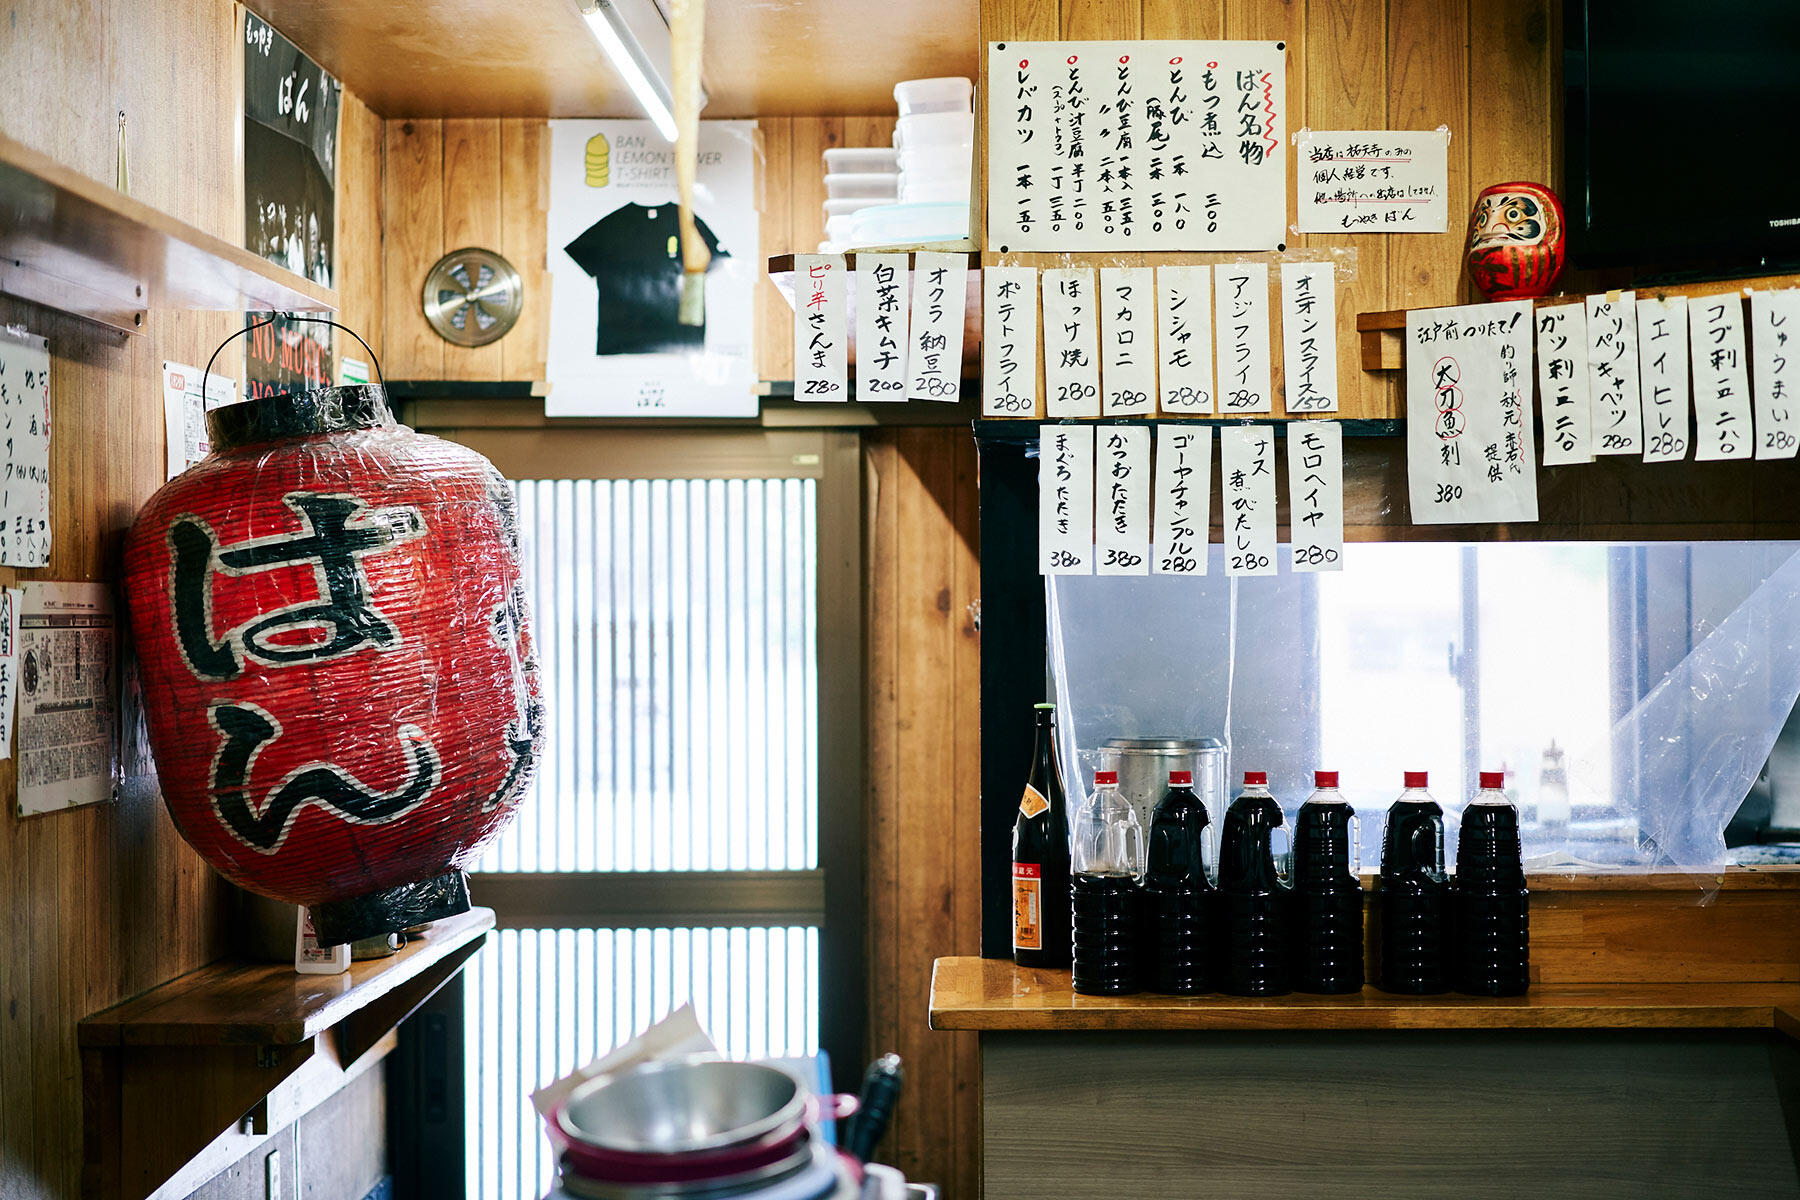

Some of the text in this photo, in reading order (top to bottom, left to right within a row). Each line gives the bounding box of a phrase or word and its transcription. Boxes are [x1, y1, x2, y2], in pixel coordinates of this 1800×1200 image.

[277, 70, 309, 124] ばん
[1018, 71, 1037, 143] レバカツ
[1170, 70, 1193, 125] とんび
[1200, 70, 1223, 159] もつ煮込
[1237, 70, 1267, 165] ばん名物
[616, 136, 645, 148] BAN
[616, 152, 668, 165] LEMON
[1173, 155, 1188, 176] 一本
[1016, 165, 1033, 189] 一本
[873, 264, 899, 370] 白菜キムチ
[1061, 280, 1088, 368] ほっけ焼
[1116, 287, 1133, 365] マカロニ
[252, 314, 275, 364] NO
[996, 279, 1022, 392] ポテトフライ
[1169, 290, 1191, 367] シシャモ
[1229, 277, 1252, 384] アジフライ
[1651, 319, 1671, 429] エイヒレ
[1771, 312, 1788, 422] しゅうまい
[805, 380, 839, 394] 280
[869, 379, 903, 392] 200
[914, 376, 957, 398] 280
[1058, 383, 1095, 401] 280
[1168, 387, 1208, 405] 280
[993, 393, 1033, 412] 280
[1112, 390, 1146, 407] 280
[1227, 390, 1259, 407] 280
[1291, 396, 1333, 411] 150
[1603, 435, 1632, 449] 280
[1650, 432, 1684, 455] 280
[1766, 431, 1795, 449] 280
[1301, 433, 1326, 527] モロヘイヤ
[1434, 484, 1462, 503] 380
[1051, 551, 1080, 567] 380
[1104, 550, 1141, 567] 380
[1232, 553, 1268, 569] 280
[1296, 545, 1338, 564] 280
[1161, 556, 1199, 575] 280
